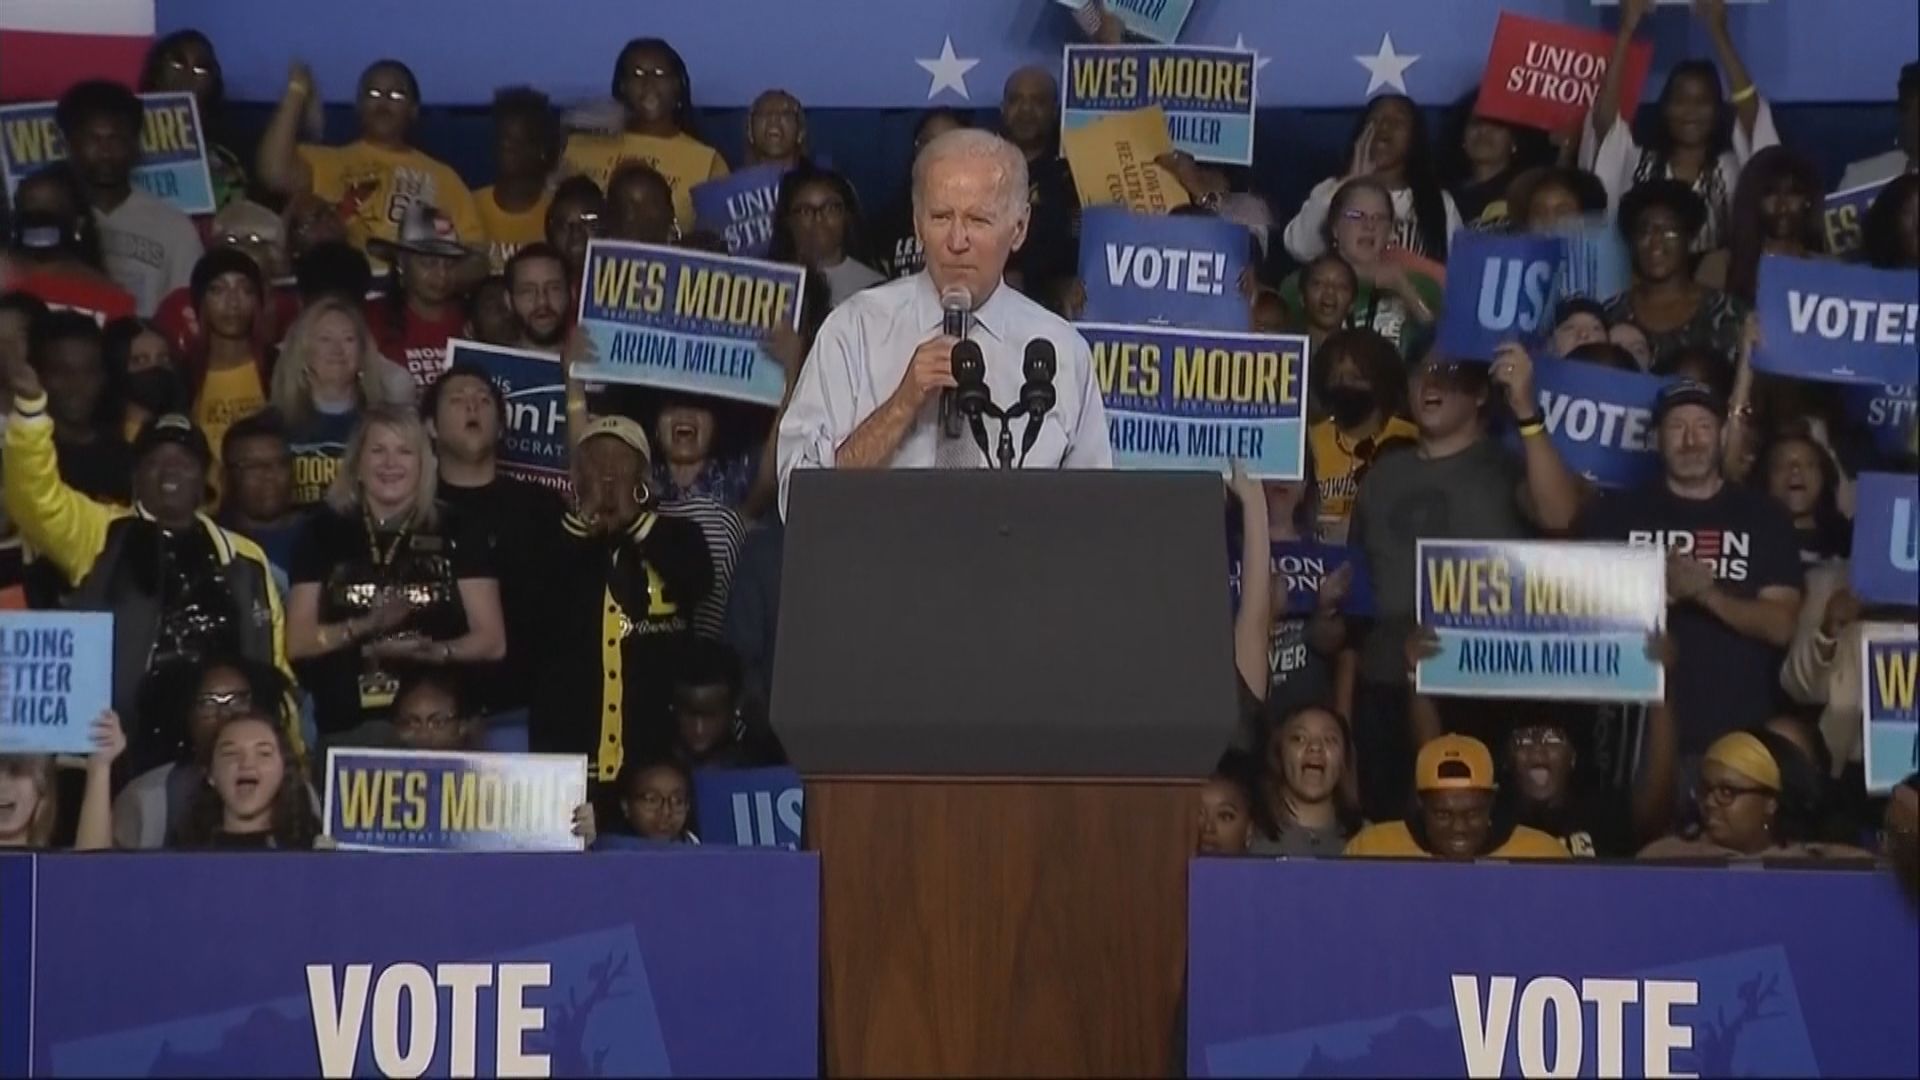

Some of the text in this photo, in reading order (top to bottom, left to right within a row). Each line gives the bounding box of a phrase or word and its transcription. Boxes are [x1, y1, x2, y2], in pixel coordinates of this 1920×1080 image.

[1073, 57, 1250, 103] WES MOORE
[1506, 65, 1600, 108] STRON
[5, 105, 197, 166] WE ORE
[726, 182, 779, 221] UNI
[1824, 203, 1862, 256] ES
[594, 256, 795, 331] WES MOORE
[1105, 243, 1227, 297] VOTE!
[610, 329, 756, 382] ARUNA MILLER
[1092, 342, 1300, 405] WES MOORE
[1110, 418, 1264, 460] ARUNA MILLER
[1538, 389, 1660, 452] VOTE
[1428, 557, 1512, 615] WES
[0, 628, 74, 658] LDING
[1268, 642, 1309, 674] VER
[1458, 637, 1621, 677] ARUNA MILLER
[0, 662, 72, 693] ETTER
[0, 696, 69, 726] ERICA
[339, 769, 428, 831] WES
[306, 962, 552, 1079] VOTE
[1450, 974, 1700, 1079] VOTE
